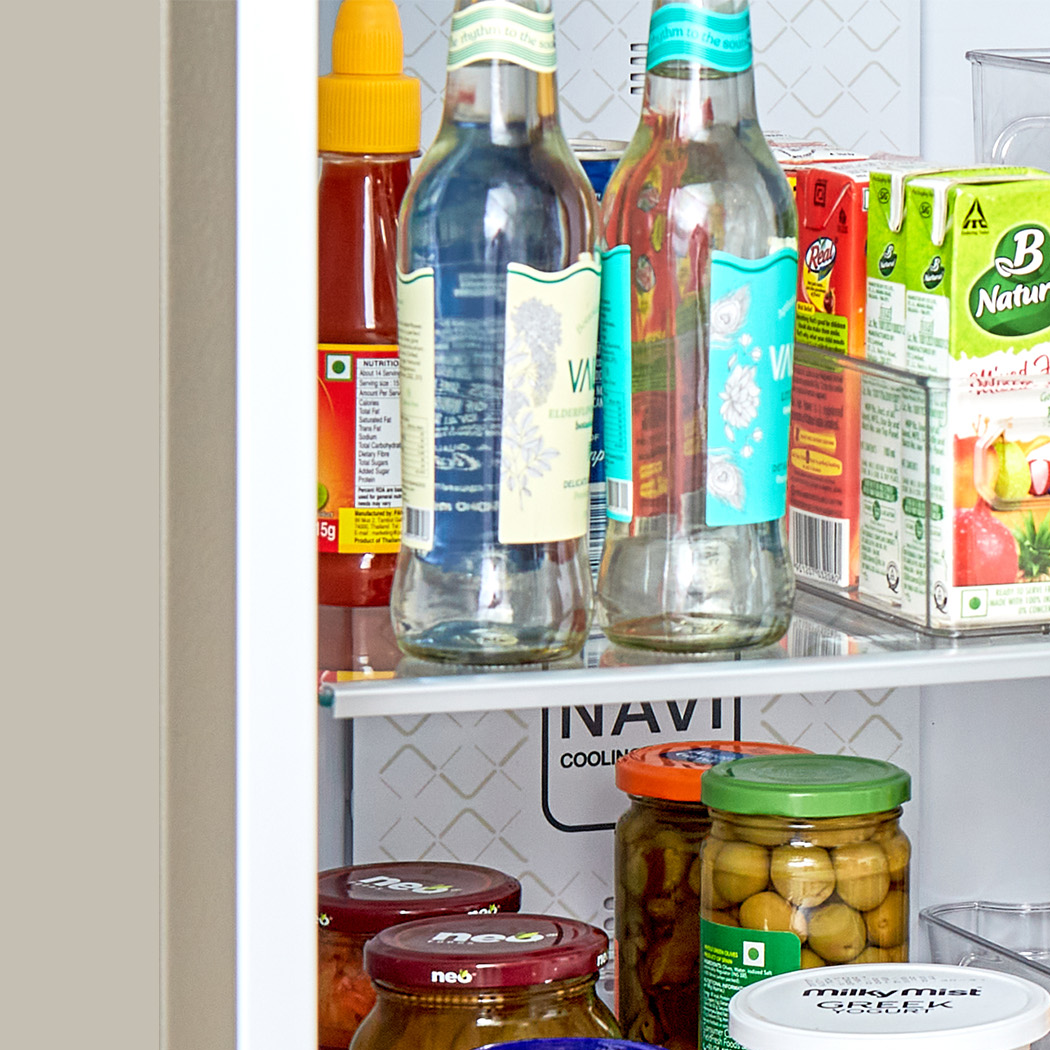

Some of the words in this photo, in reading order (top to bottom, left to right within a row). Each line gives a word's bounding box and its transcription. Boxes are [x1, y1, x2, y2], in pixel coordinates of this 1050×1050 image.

[808, 244, 834, 273] Real
[560, 747, 624, 769] COOLIN
[360, 874, 453, 894] neo
[433, 930, 546, 943] neo
[431, 968, 473, 985] neo
[817, 1000, 953, 1009] GREEK
